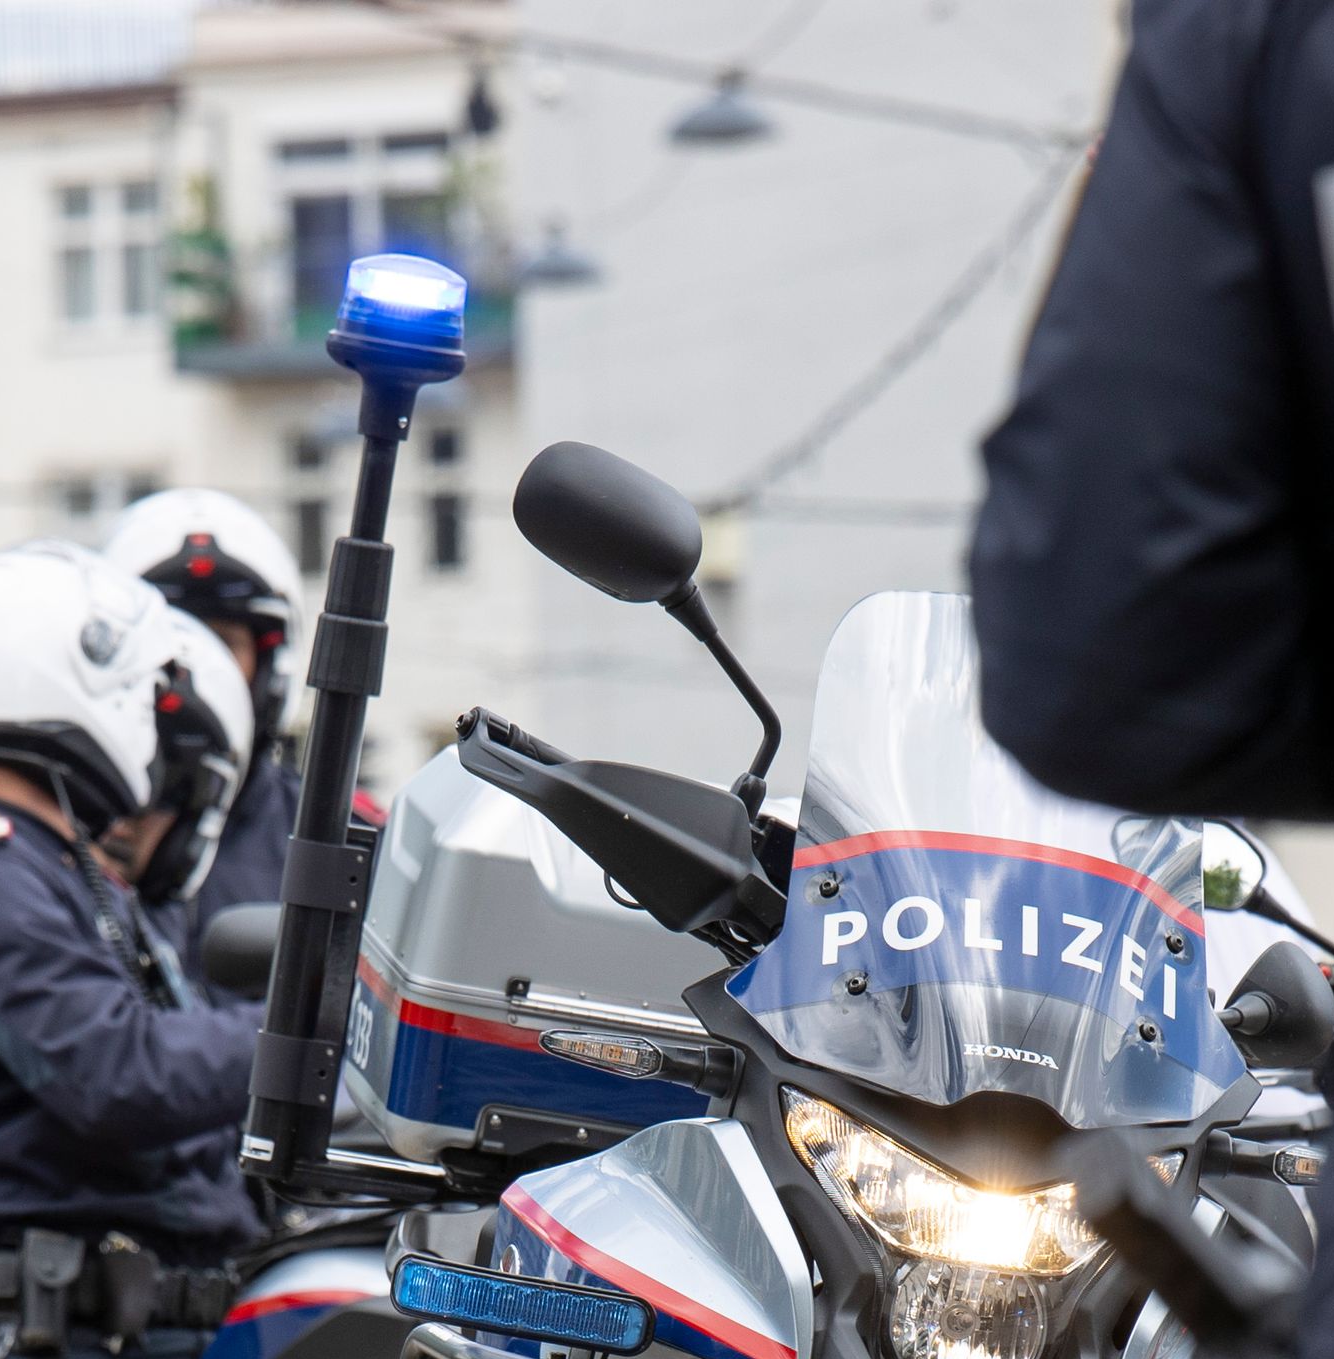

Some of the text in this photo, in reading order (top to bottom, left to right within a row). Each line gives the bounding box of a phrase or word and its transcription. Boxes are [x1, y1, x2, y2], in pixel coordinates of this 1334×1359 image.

[820, 894, 1178, 1020] POLIZEI
[351, 1001, 374, 1070] 133
[963, 1043, 1060, 1071] HONDA
